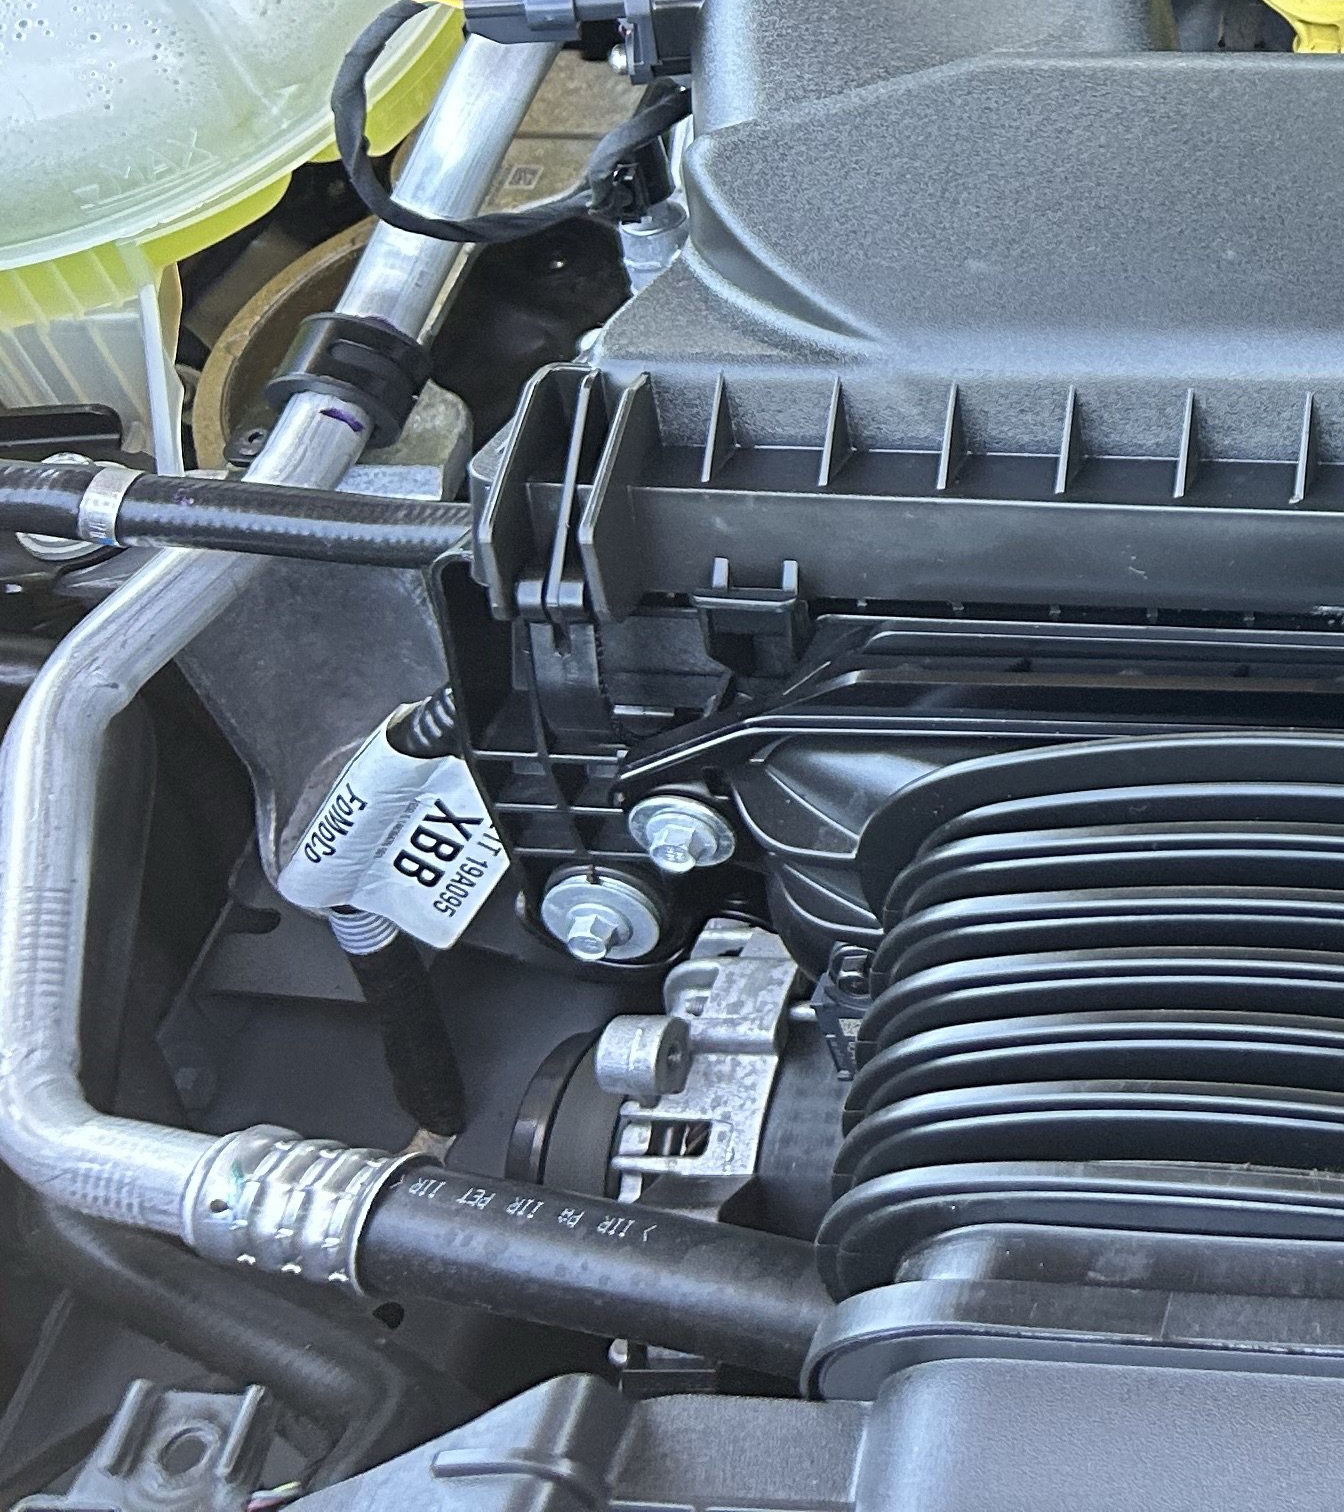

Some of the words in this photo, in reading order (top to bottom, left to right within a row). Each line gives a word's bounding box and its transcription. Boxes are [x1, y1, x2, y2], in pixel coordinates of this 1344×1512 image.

[99, 127, 213, 194] MAX
[305, 783, 368, 863] FoMoCo
[393, 798, 484, 888] XBB
[433, 857, 488, 918] 19A095
[456, 1188, 496, 1210] PET
